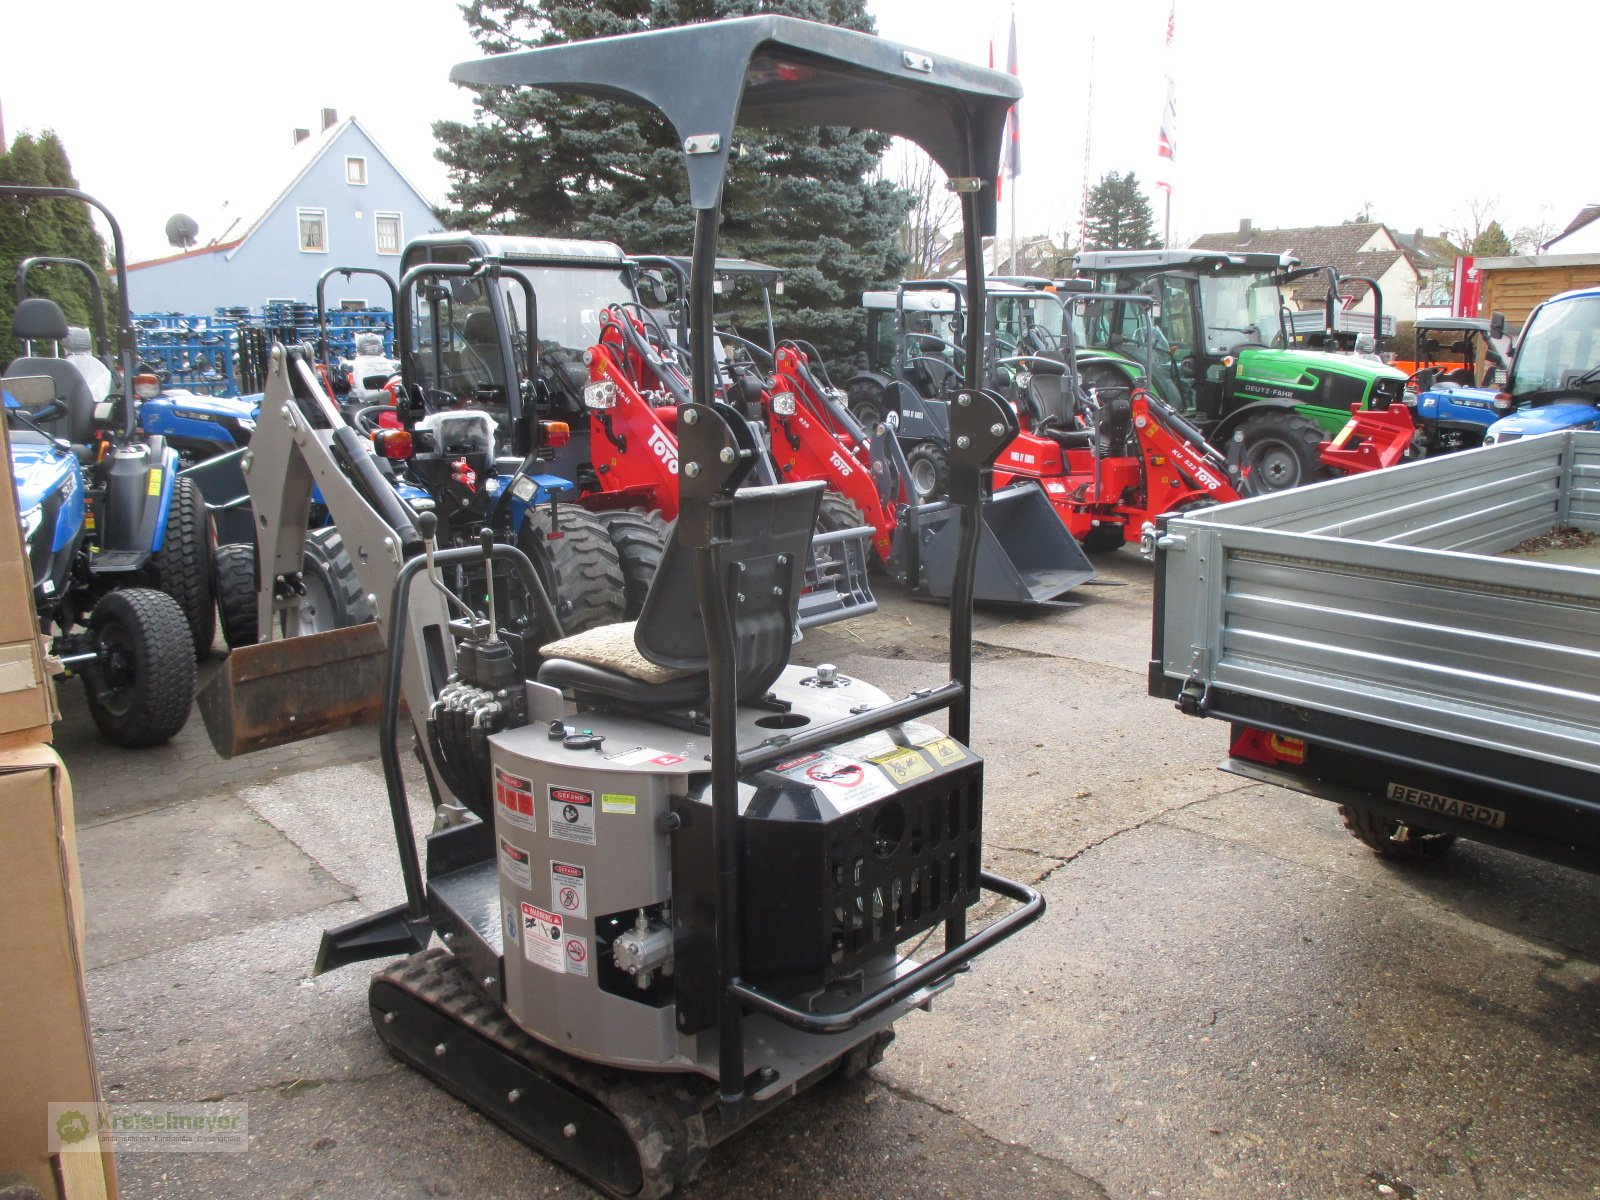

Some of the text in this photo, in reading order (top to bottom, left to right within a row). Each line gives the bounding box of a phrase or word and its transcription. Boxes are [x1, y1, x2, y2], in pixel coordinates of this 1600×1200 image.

[647, 423, 678, 474] TOYO
[829, 450, 854, 477] TOYO
[1194, 466, 1222, 490] TOYO
[557, 790, 584, 801] GEFAHR
[1391, 785, 1499, 826] BERNARDI
